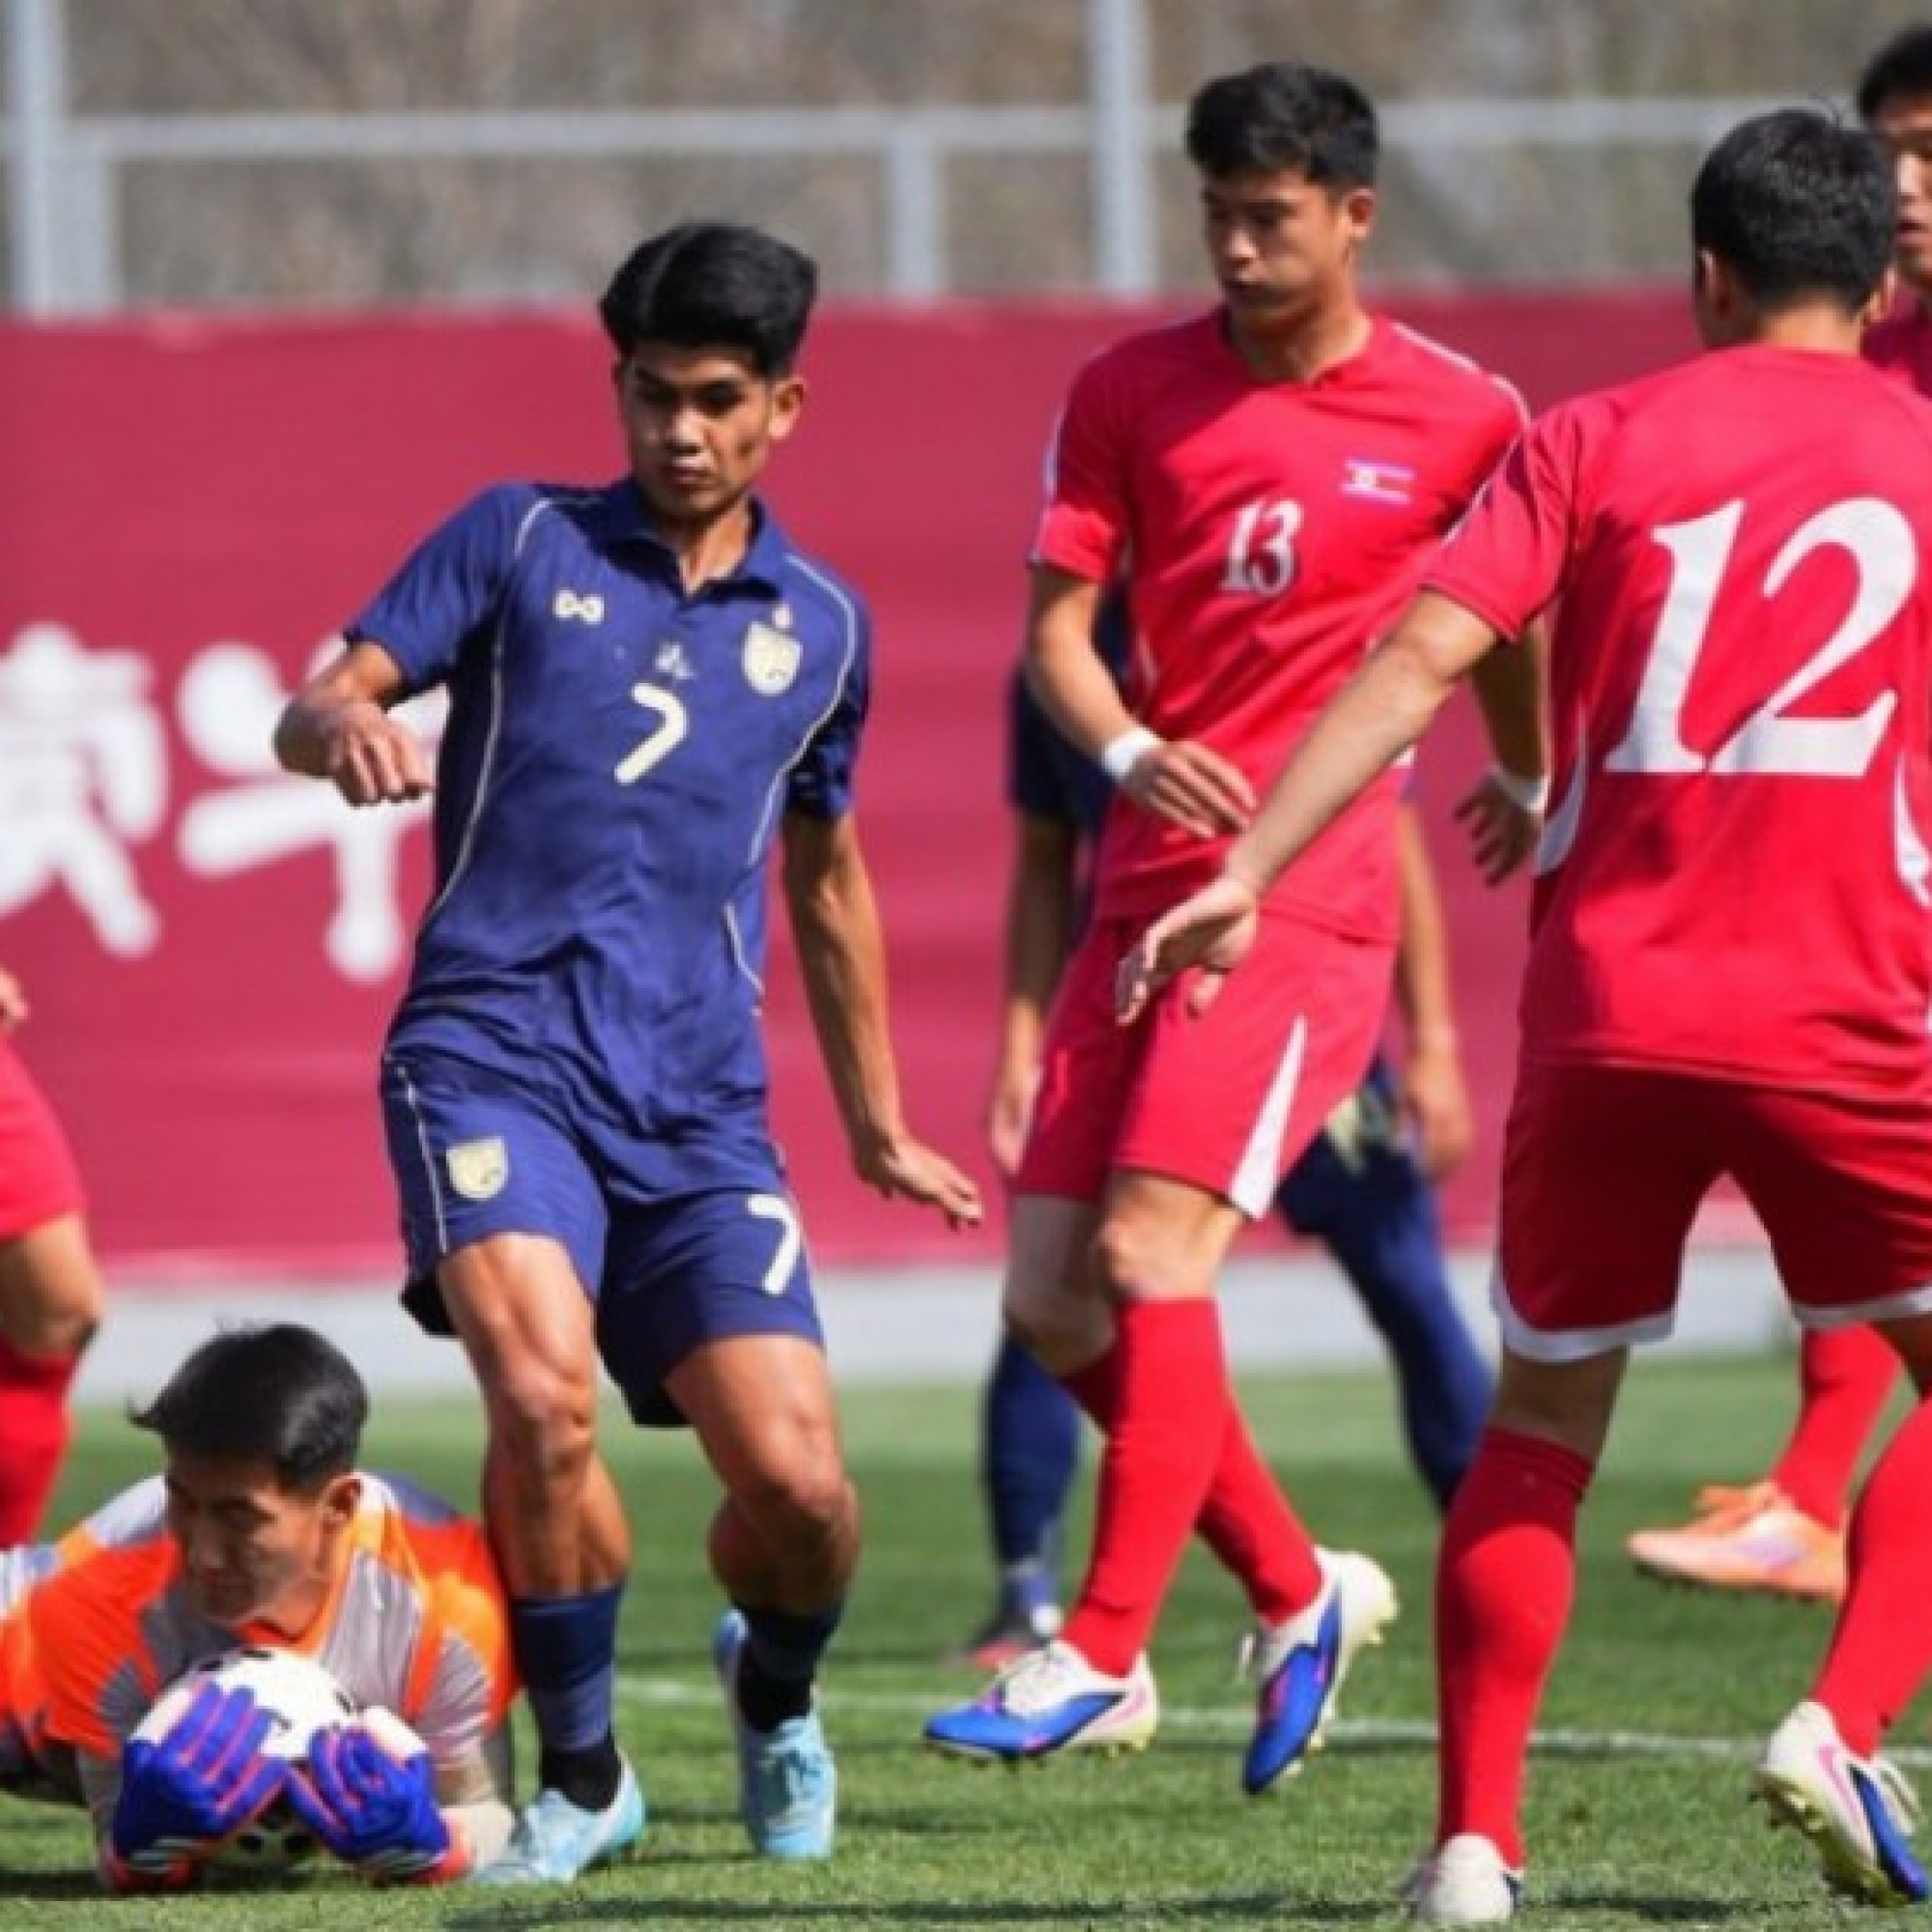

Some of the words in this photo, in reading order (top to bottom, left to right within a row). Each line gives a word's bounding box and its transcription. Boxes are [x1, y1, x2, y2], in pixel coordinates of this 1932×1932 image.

[1221, 500, 1302, 597] 13
[1604, 497, 1918, 777] 12
[614, 683, 688, 784] 7
[746, 1194, 801, 1294] 7
